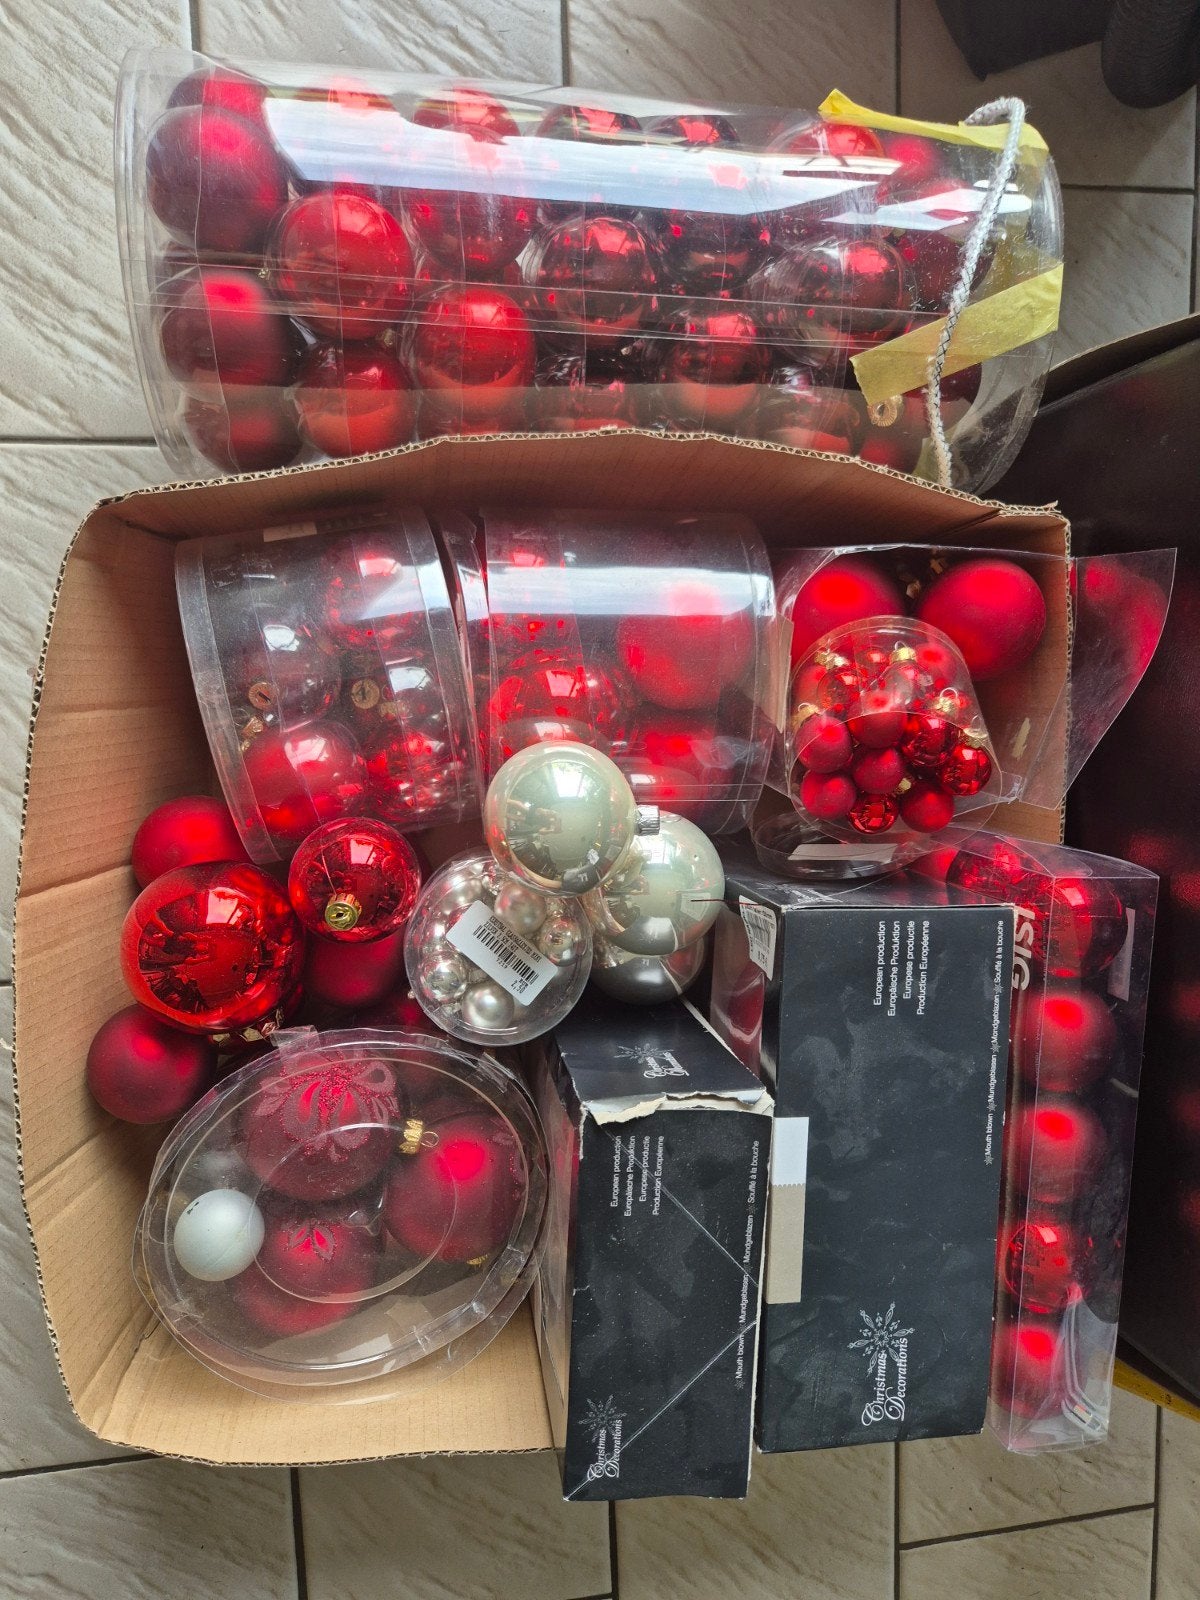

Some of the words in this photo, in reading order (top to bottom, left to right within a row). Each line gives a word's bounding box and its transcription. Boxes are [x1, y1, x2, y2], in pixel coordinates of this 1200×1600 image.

[877, 921, 885, 965] production
[890, 921, 900, 965] Produktion
[906, 921, 915, 960] productie
[919, 921, 930, 970] Européenne
[511, 979, 527, 994] 2,50
[873, 966, 884, 1006] European
[887, 966, 898, 1016] Europäische
[903, 961, 913, 999] Europese
[994, 961, 1003, 983] Soufflé
[917, 971, 927, 1015] Production
[613, 1135, 621, 1173] production
[642, 1135, 651, 1168] productie
[751, 1140, 759, 1166] bouche
[610, 1173, 620, 1207] European
[652, 1177, 662, 1216] Production
[862, 1350, 888, 1426] Christmas
[884, 1337, 909, 1421] Decorations
